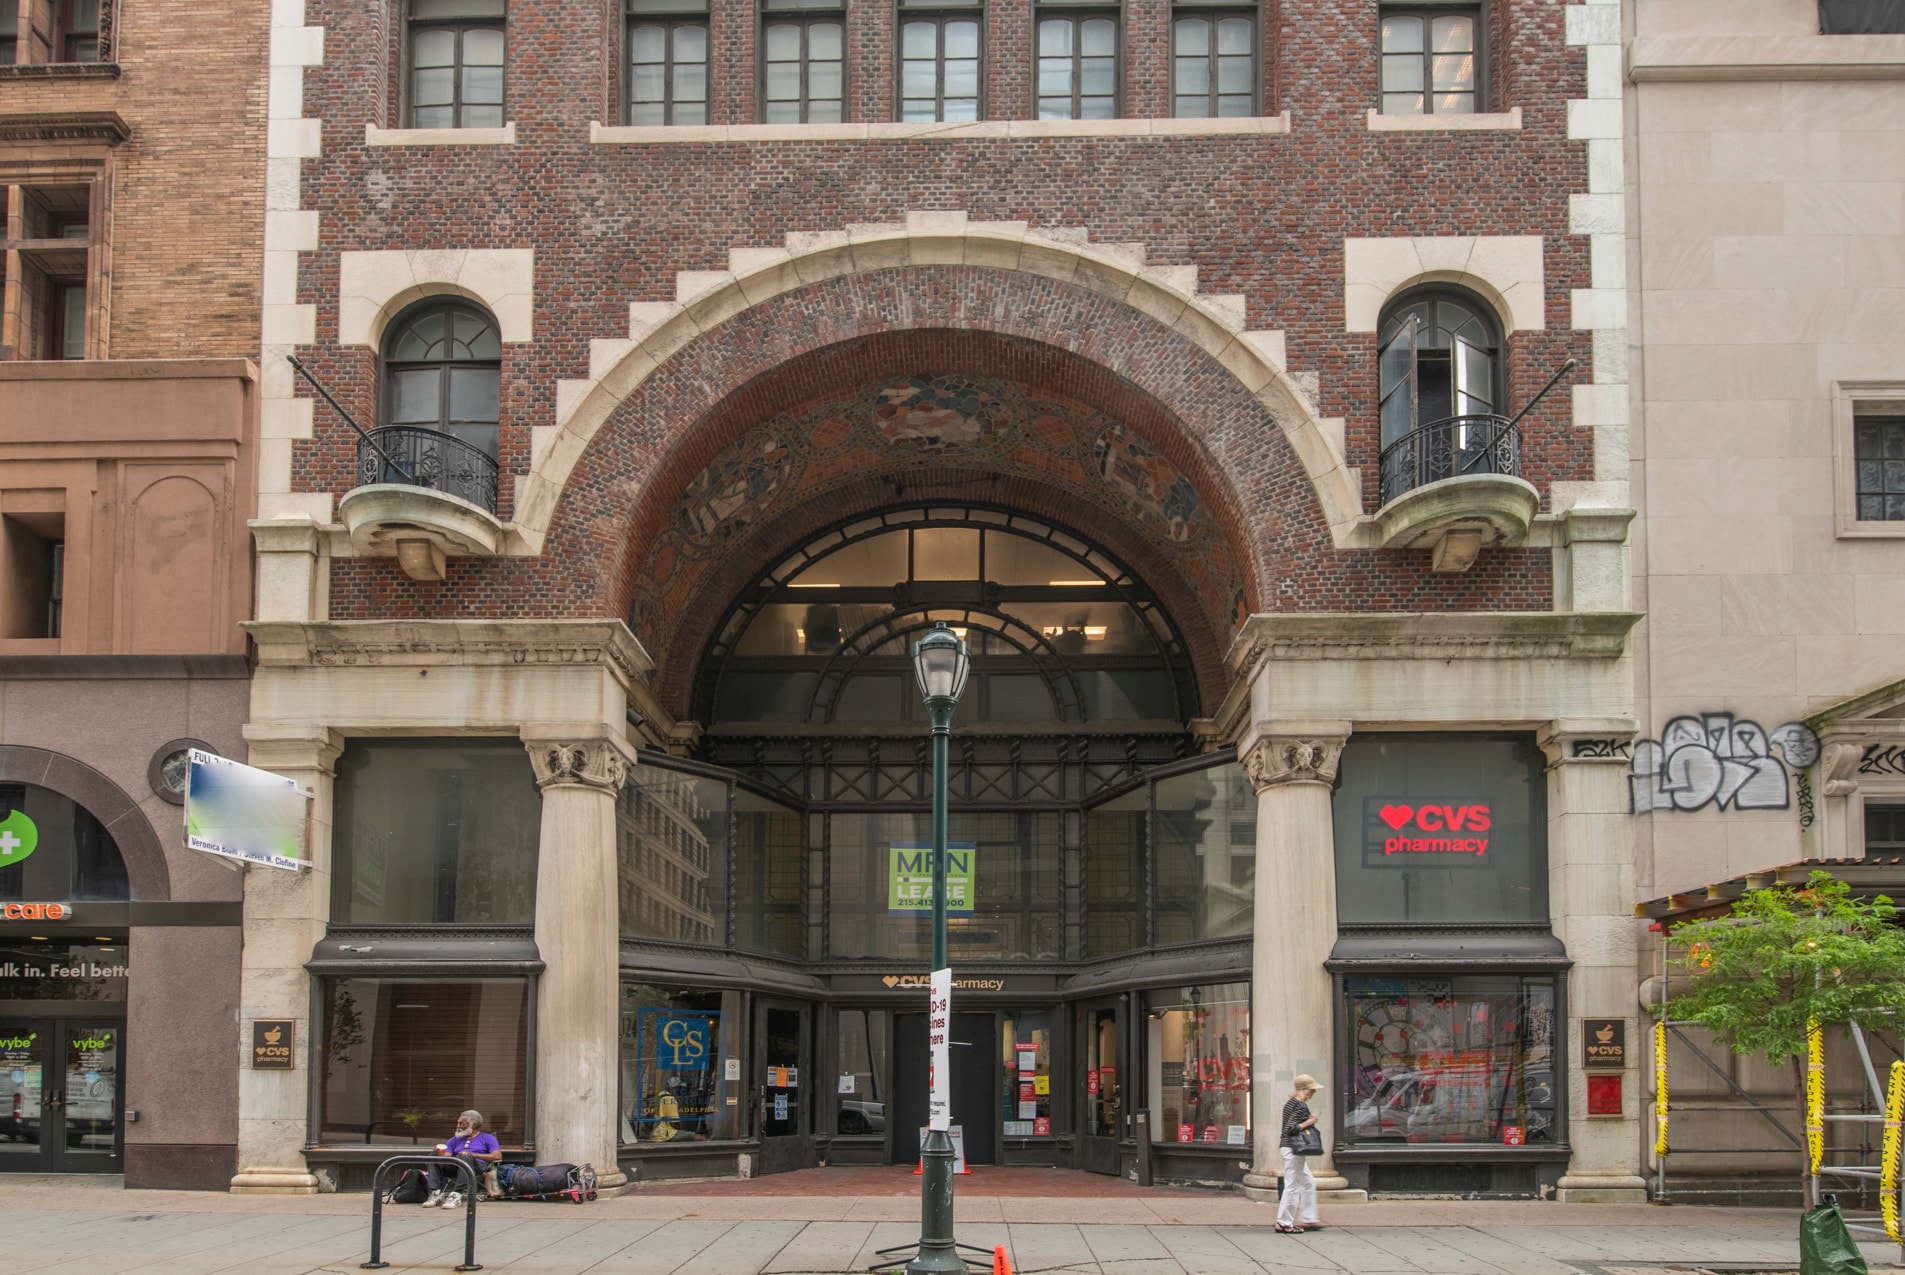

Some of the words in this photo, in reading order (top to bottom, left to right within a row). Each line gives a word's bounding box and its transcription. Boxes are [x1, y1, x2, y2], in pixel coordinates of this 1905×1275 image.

[1416, 805, 1492, 832] CVS
[191, 837, 220, 852] Veronica
[1384, 834, 1488, 856] pharmacy
[5, 904, 63, 919] care
[25, 963, 46, 977] in.
[51, 963, 86, 977] Feel
[0, 1037, 31, 1051] vybe
[73, 1038, 105, 1051] vybe
[1599, 1046, 1623, 1055] CVS
[266, 1047, 290, 1056] CVS
